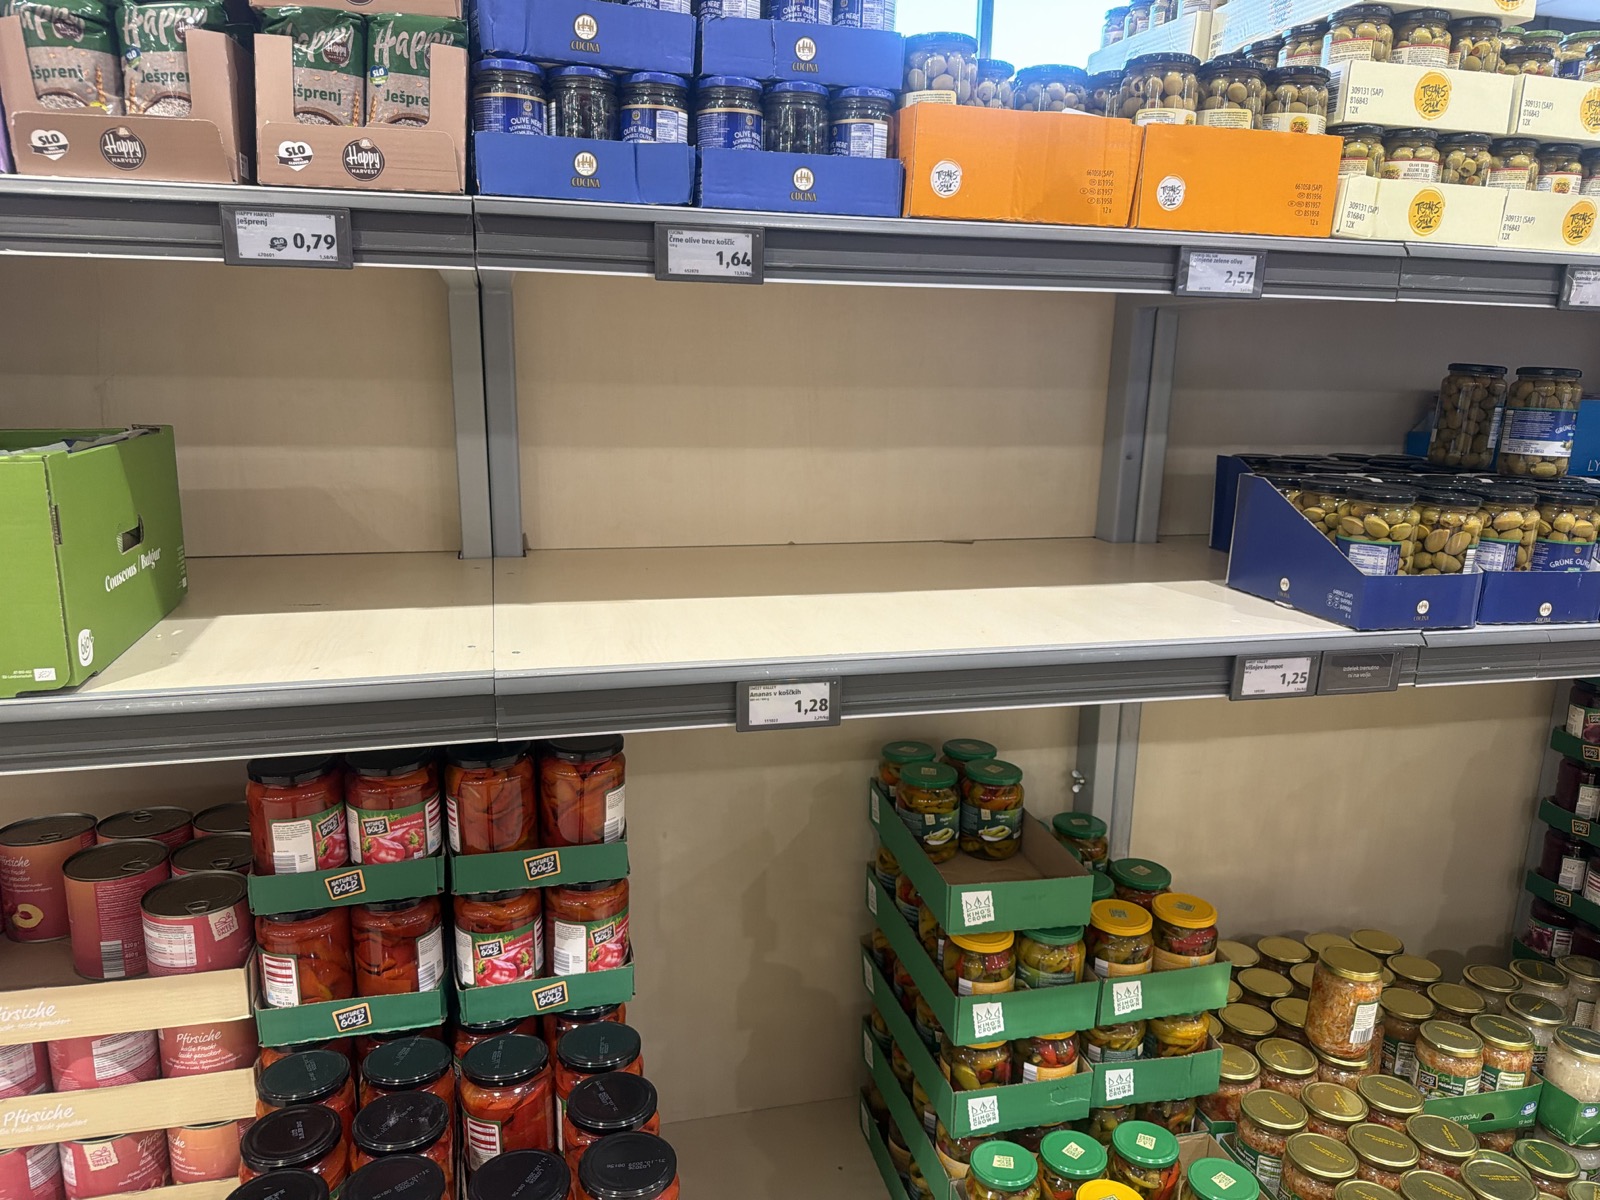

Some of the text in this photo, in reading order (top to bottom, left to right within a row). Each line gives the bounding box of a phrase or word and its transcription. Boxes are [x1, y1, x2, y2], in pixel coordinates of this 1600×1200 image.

[122, 3, 208, 47] Happy
[571, 40, 600, 53] CUCINA
[372, 68, 385, 77] SLO
[792, 62, 819, 73] CUCINA
[32, 65, 84, 82] ešprenj
[141, 69, 190, 86] Ješpre
[293, 86, 342, 105] ešprenj
[1351, 86, 1370, 95] 309131
[384, 89, 430, 107] Ješpre
[510, 117, 529, 125] OLIVE
[623, 126, 653, 135] OLIVE NERE
[38, 133, 60, 145] SLO
[104, 133, 141, 158] Happy
[285, 145, 306, 157] SLO
[345, 146, 380, 169] Happy
[571, 177, 600, 188] CUCINA
[789, 191, 817, 202] CUCINA
[1349, 201, 1367, 212] 309131
[1346, 211, 1365, 221] 816843
[1505, 214, 1521, 222] 309131
[237, 218, 268, 226] ješprenj
[293, 233, 336, 252] 0,79
[669, 235, 684, 244] Črne
[716, 238, 735, 246] koščic
[716, 251, 751, 269] 1,64
[1225, 270, 1254, 286] 2,57
[1555, 424, 1571, 434] GRÜNE
[1549, 559, 1574, 568] GRÜNE
[105, 563, 137, 592] Couscous
[141, 548, 161, 569] Bulgur
[1280, 672, 1307, 686] 1,25
[795, 698, 828, 715] 1,28
[367, 825, 384, 834] GOLD
[529, 856, 554, 868] NATURE'S
[531, 862, 554, 875] GOLD
[331, 874, 358, 886] NATURE'S
[334, 881, 358, 894] GOLD
[967, 909, 991, 917] KING'S
[967, 914, 991, 922] CROWN
[596, 931, 611, 943] GOLD
[480, 942, 499, 950] NATURE'S
[481, 948, 499, 956] GOLD
[538, 986, 562, 999] NATURE'S
[539, 993, 562, 1006] GOLD
[1117, 998, 1139, 1007] KING'S
[1118, 1003, 1140, 1011] CROWN
[338, 1008, 365, 1020] NATURE'S
[341, 1015, 365, 1028] GOLD
[978, 1020, 1000, 1029] KING'S
[978, 1025, 1001, 1034] CROWN
[176, 1029, 221, 1045] Pfirsiche
[1109, 1084, 1131, 1092] KING'S
[1109, 1089, 1131, 1097] CROWN
[3, 1103, 75, 1127] Pfirsiche
[973, 1112, 995, 1122] KING'S
[973, 1117, 996, 1127] CROWN
